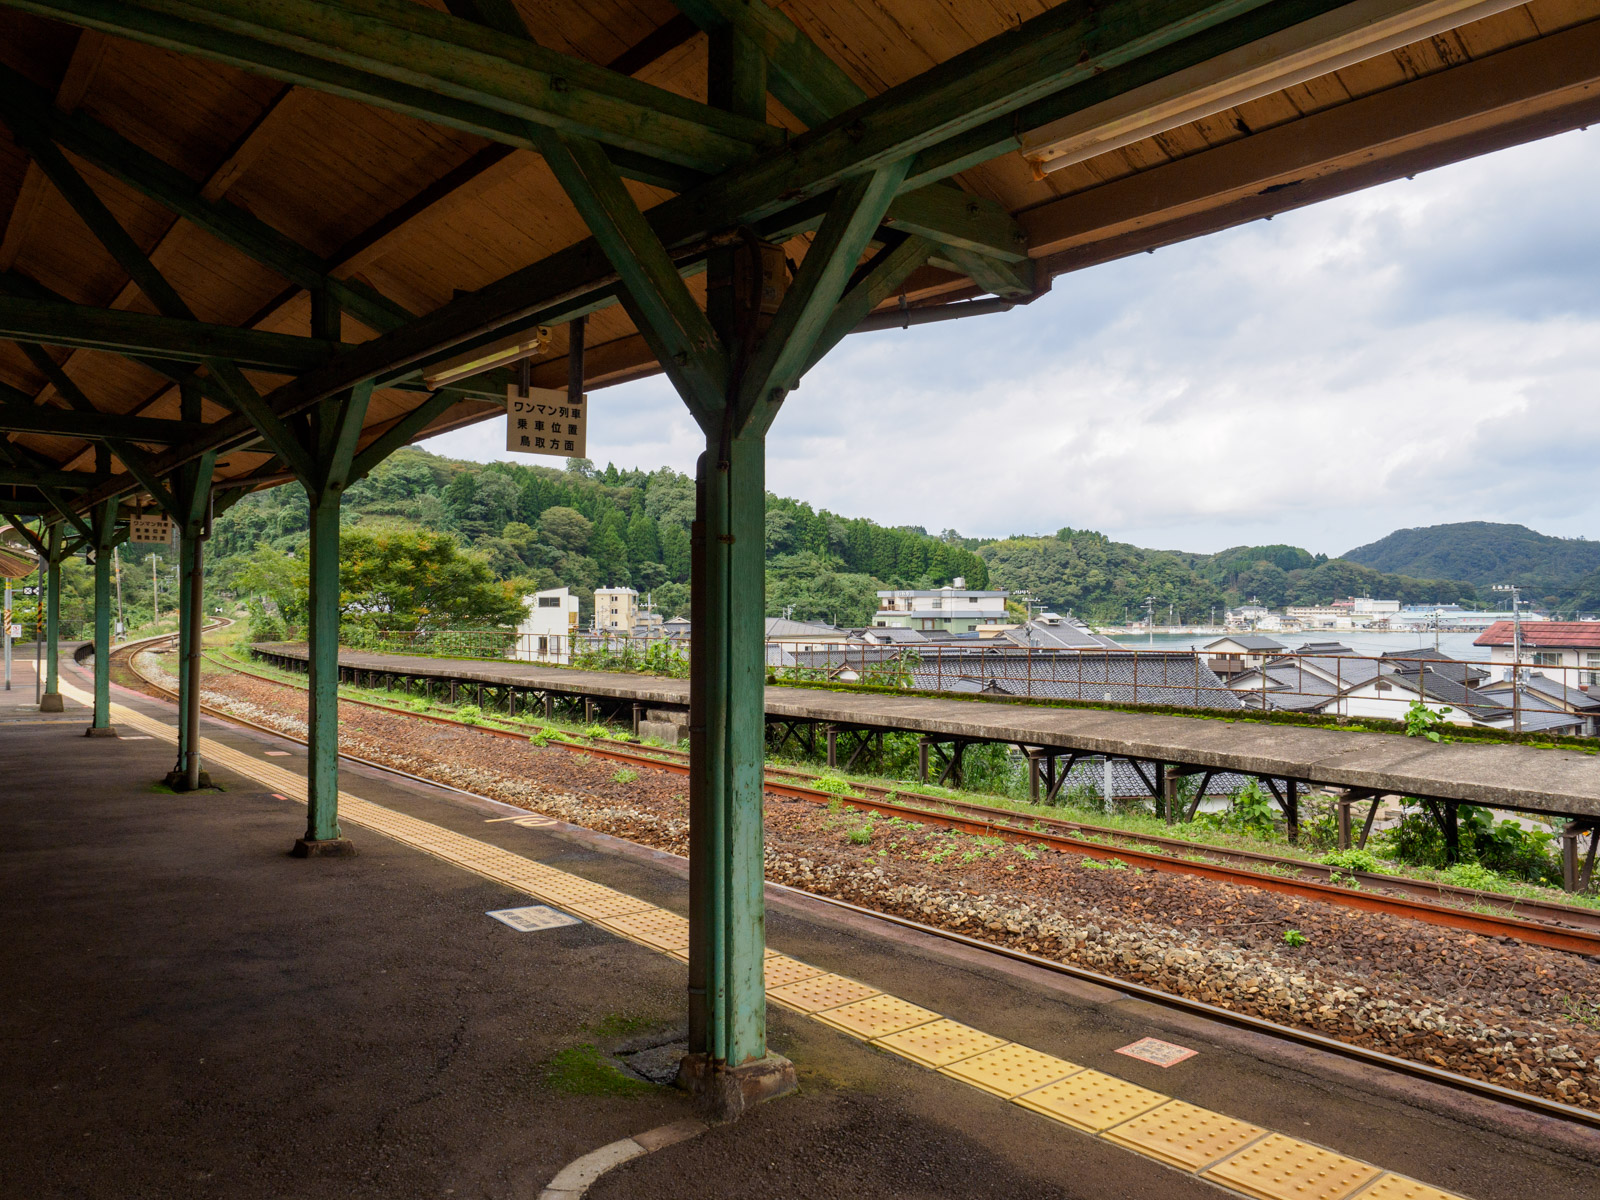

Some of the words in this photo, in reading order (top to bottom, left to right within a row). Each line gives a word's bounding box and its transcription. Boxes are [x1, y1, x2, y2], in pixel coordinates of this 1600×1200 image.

[514, 401, 581, 419] ワンマン列車
[517, 418, 578, 436] 乗車位置
[520, 435, 574, 451] 鳥取方面
